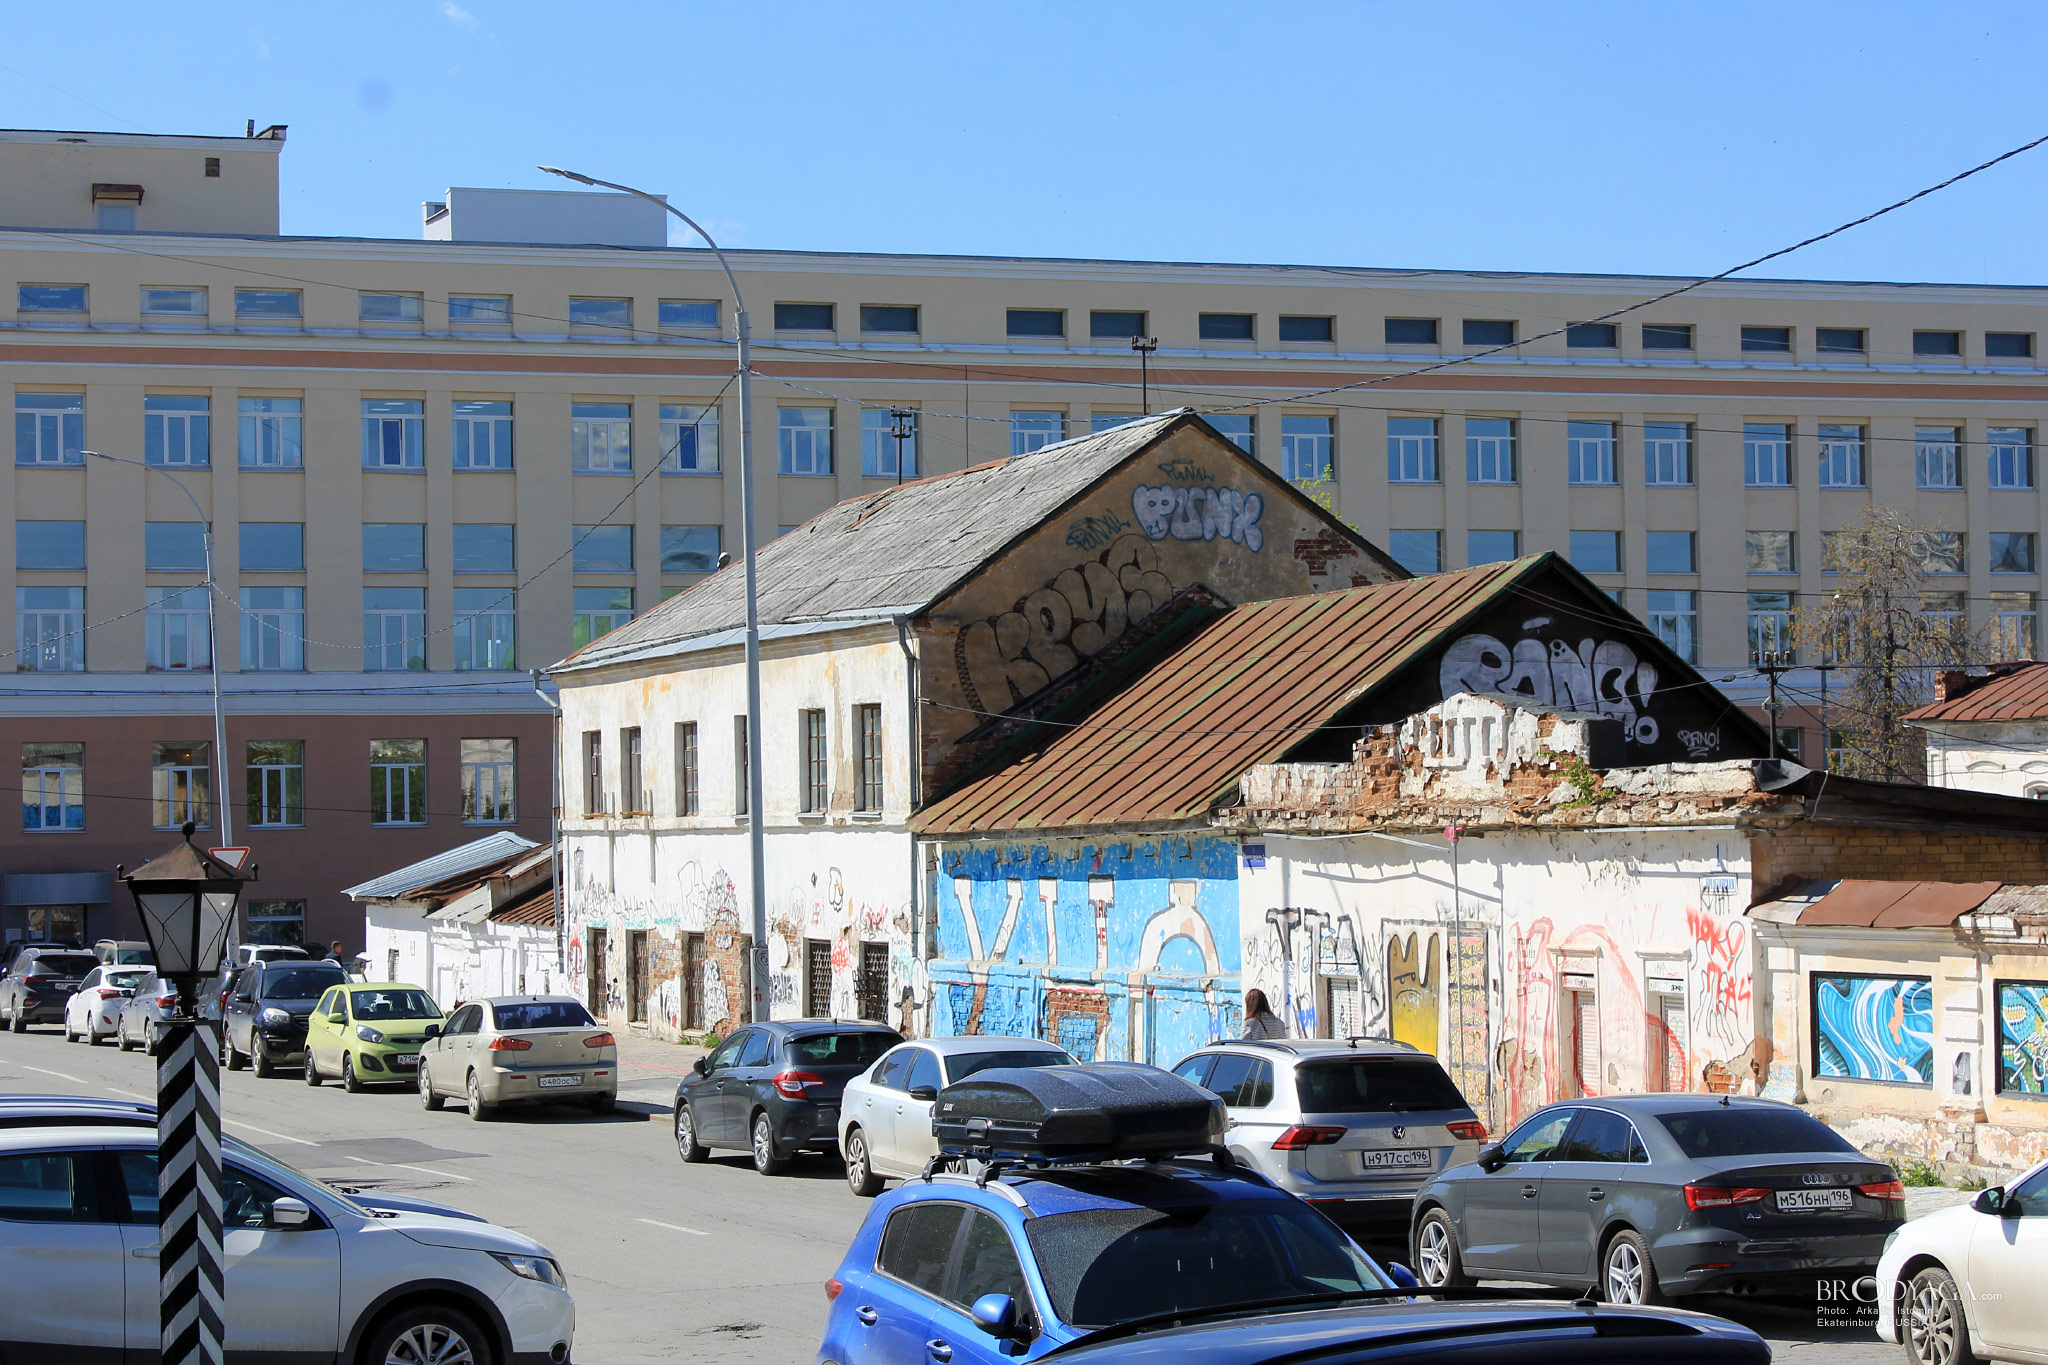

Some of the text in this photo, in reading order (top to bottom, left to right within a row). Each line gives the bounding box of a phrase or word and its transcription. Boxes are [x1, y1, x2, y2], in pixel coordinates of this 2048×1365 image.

[1368, 1151, 1427, 1165] Н917СС 196
[1779, 1190, 1849, 1207] М516НН 196
